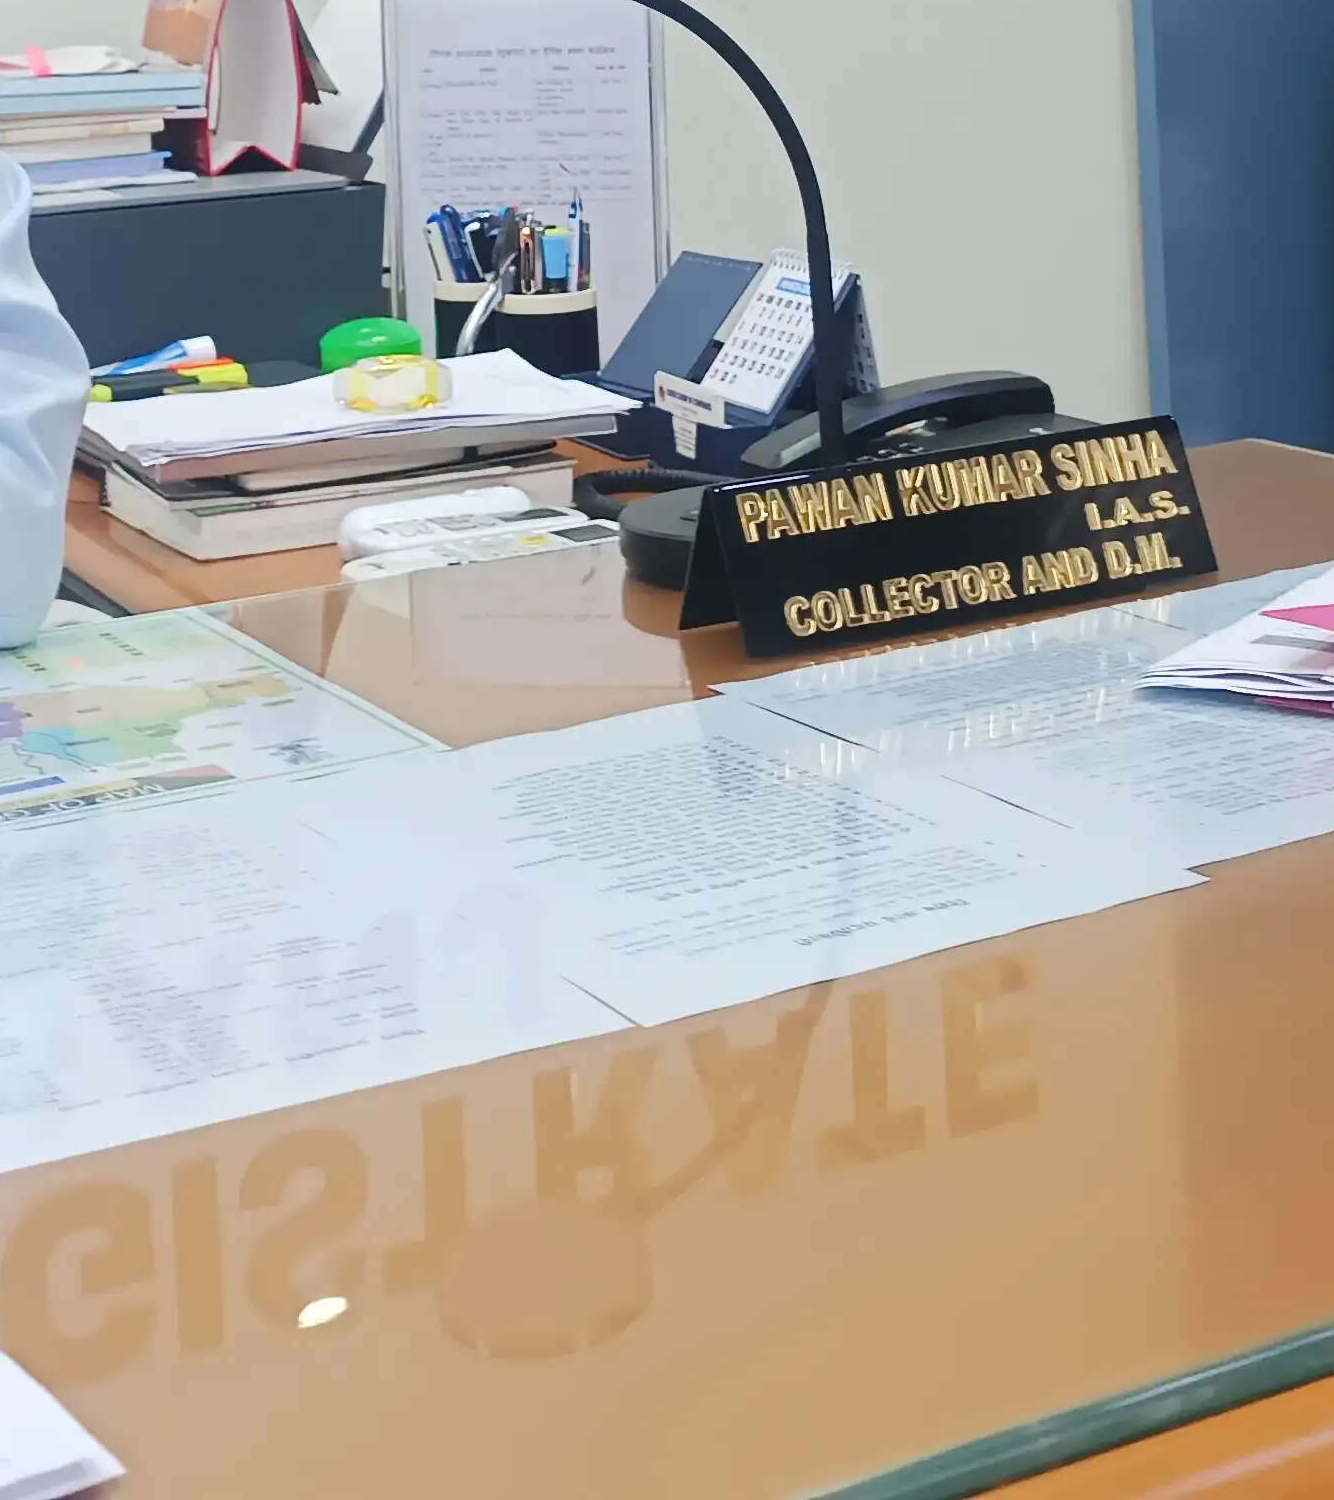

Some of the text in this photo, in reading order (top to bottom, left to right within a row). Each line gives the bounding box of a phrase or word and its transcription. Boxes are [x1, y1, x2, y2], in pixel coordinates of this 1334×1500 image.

[736, 429, 1178, 543] PAWAN KUMAR SINHA
[1084, 489, 1190, 531] I.A.S.
[784, 531, 1183, 638] COLLECTOR AND D.M.
[96, 782, 163, 804] MAP
